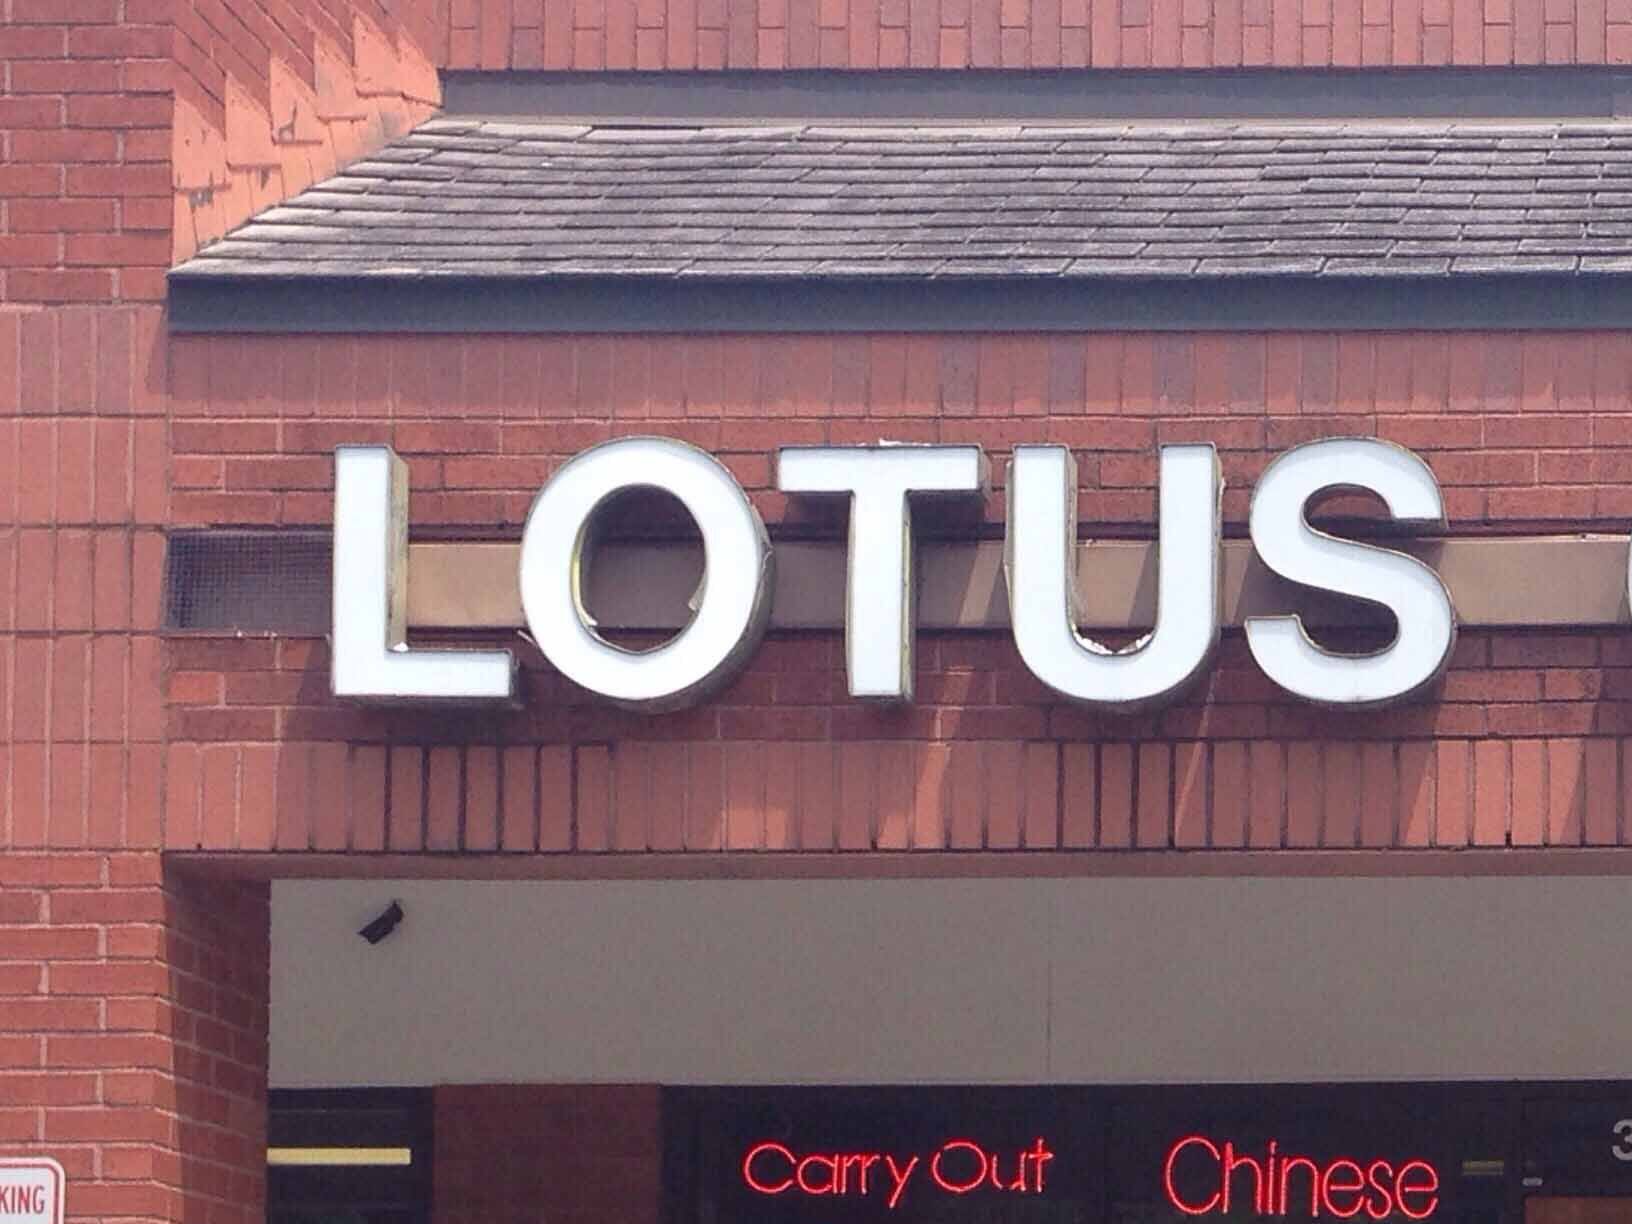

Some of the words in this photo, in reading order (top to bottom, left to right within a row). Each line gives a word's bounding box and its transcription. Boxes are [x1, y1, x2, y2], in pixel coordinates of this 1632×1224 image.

[331, 437, 1454, 704] LOTUS
[742, 1138, 919, 1208] Carry
[928, 1136, 1056, 1195] Out
[1162, 1133, 1441, 1221] Chinese
